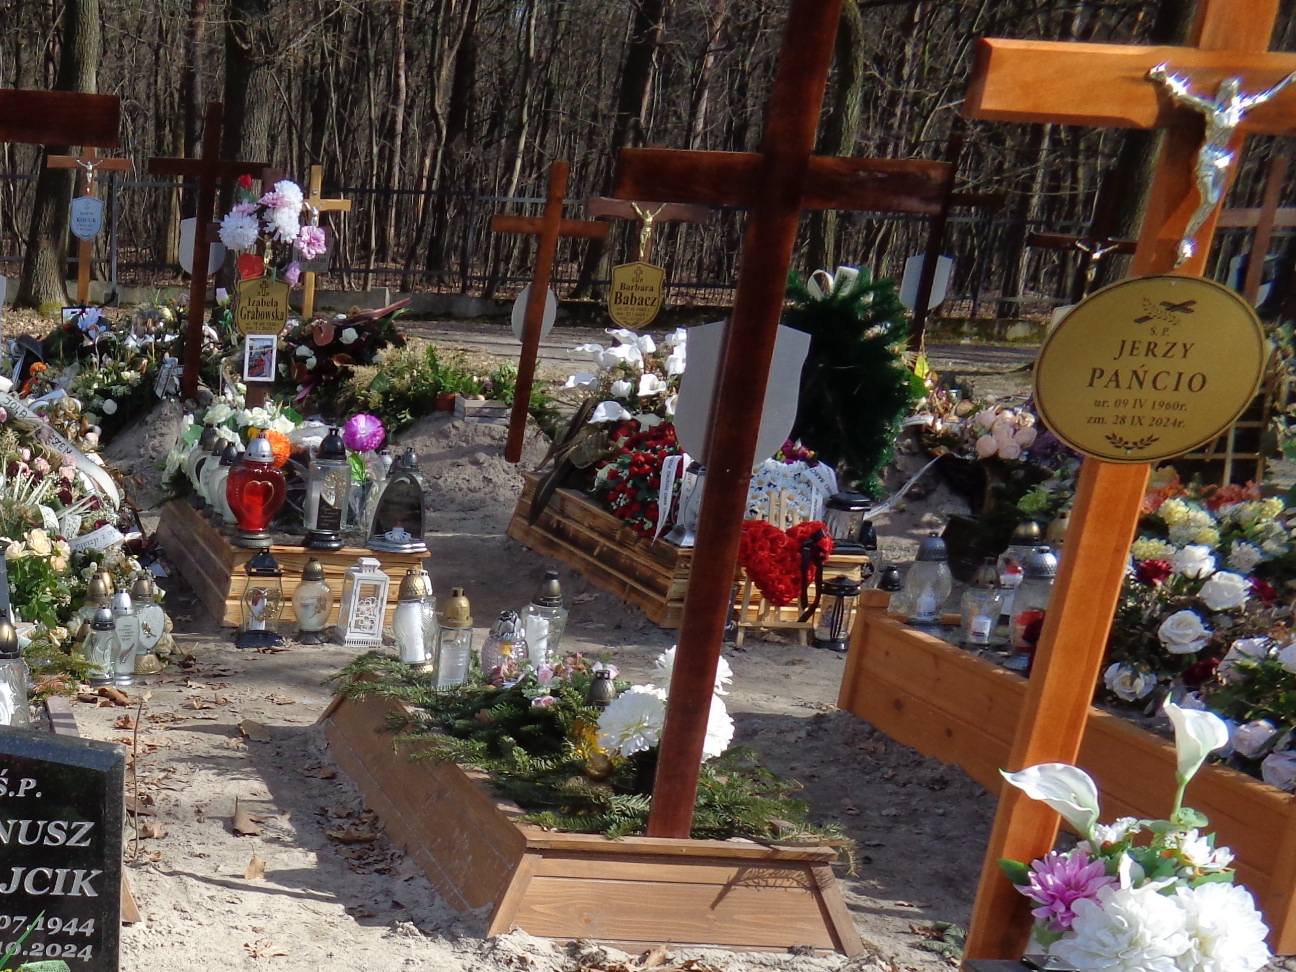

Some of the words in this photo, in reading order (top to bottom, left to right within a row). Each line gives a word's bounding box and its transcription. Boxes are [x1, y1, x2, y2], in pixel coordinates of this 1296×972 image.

[620, 282, 654, 292] Barbara
[248, 297, 279, 307] Izabela
[614, 291, 657, 306] Babacz
[240, 306, 285, 320] Grabowska
[1113, 339, 1195, 360] JERZY
[1086, 363, 1208, 393] PAŃCIO
[1094, 399, 1110, 408] ur.
[1114, 398, 1129, 408] 09
[1132, 398, 1147, 409] IV
[1151, 400, 1188, 412] 1960r.
[1086, 415, 1108, 424] zm.
[1113, 414, 1127, 425] 28
[1130, 415, 1145, 426] IX
[1149, 416, 1186, 428] 2024r.
